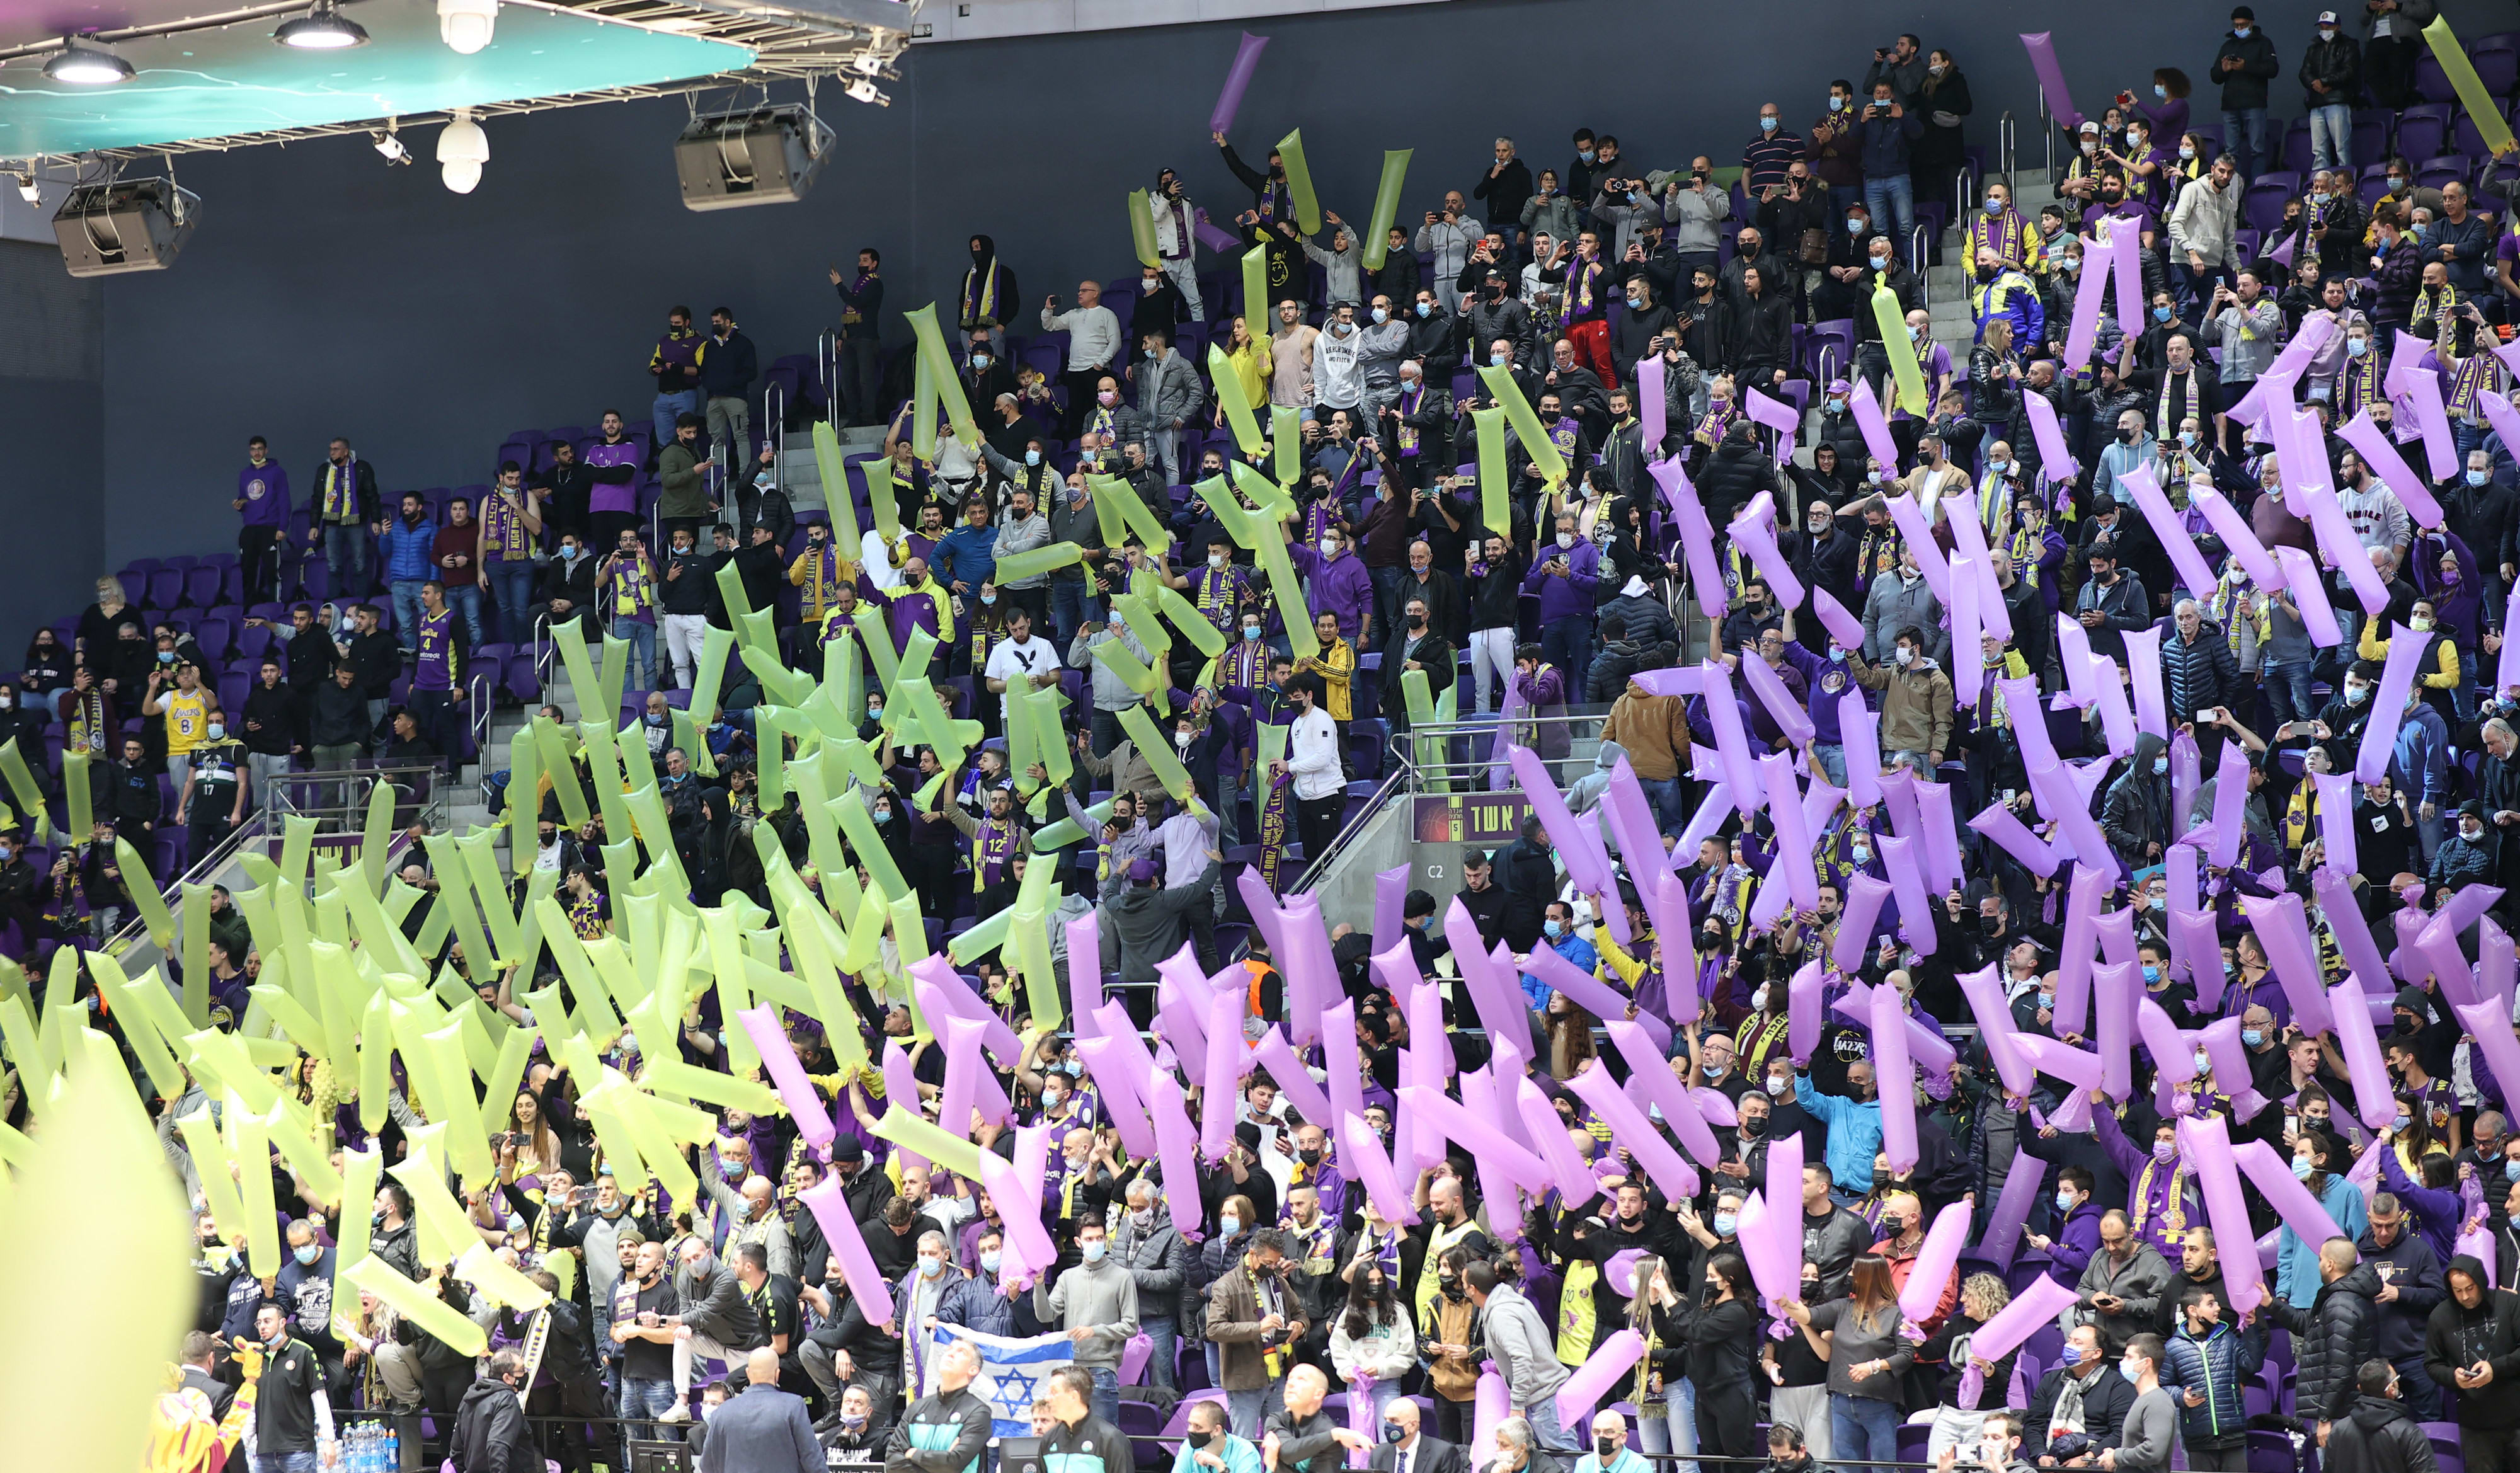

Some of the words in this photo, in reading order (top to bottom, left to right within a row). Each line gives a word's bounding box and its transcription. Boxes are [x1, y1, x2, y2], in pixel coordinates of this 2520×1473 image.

[1326, 346, 1356, 357] ABERCROMBIE
[2352, 525, 2370, 535] ING
[423, 638, 431, 650] 4
[173, 708, 201, 719] LAKERS
[181, 719, 193, 735] 8
[203, 784, 214, 795] 17
[1470, 805, 1513, 832] אשד
[988, 839, 1003, 852] 12
[1266, 851, 1276, 869] 2008
[1428, 865, 1443, 878] C2
[2139, 1174, 2151, 1196] HAPOEL
[2171, 1187, 2179, 1208] HOLON
[1423, 1256, 1436, 1274] 25
[1564, 1289, 1574, 1303] 10
[306, 1302, 330, 1310] YEARS
